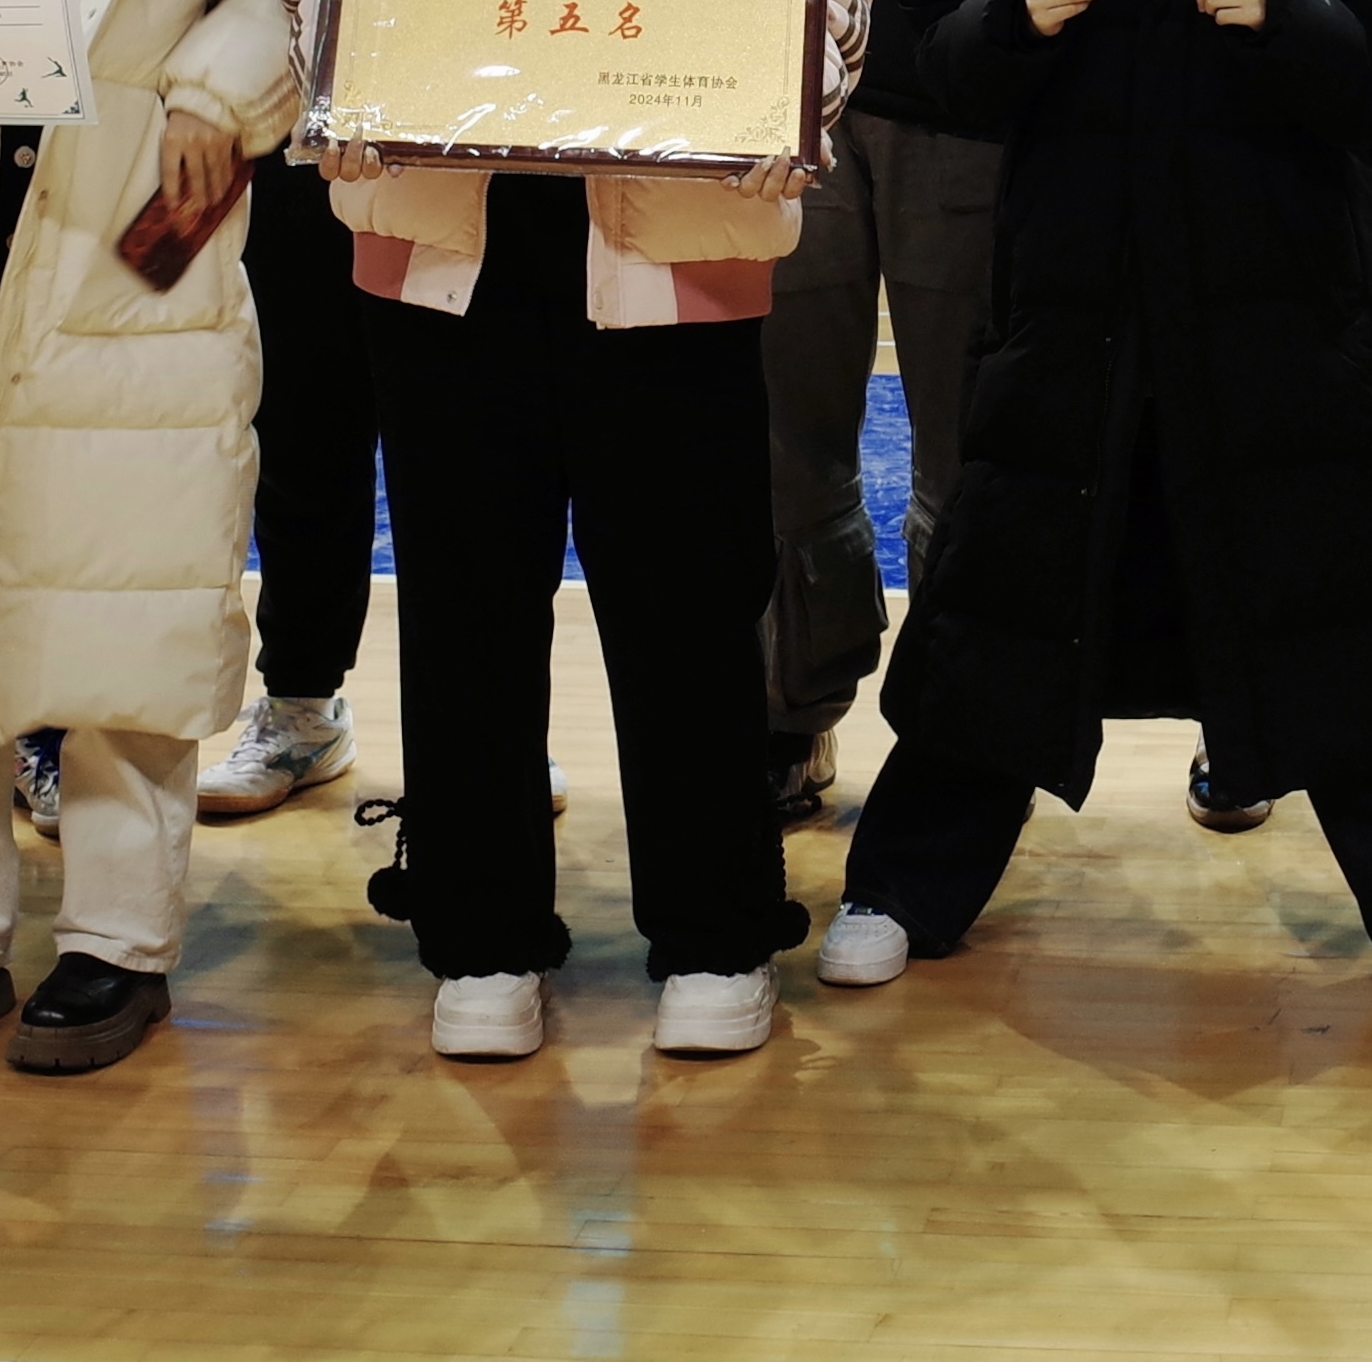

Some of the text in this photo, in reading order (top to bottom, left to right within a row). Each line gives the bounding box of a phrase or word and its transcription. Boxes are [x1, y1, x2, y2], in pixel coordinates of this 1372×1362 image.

[597, 71, 738, 90] 黑龙江省学生体育协会
[628, 93, 703, 108] 2024年11月
